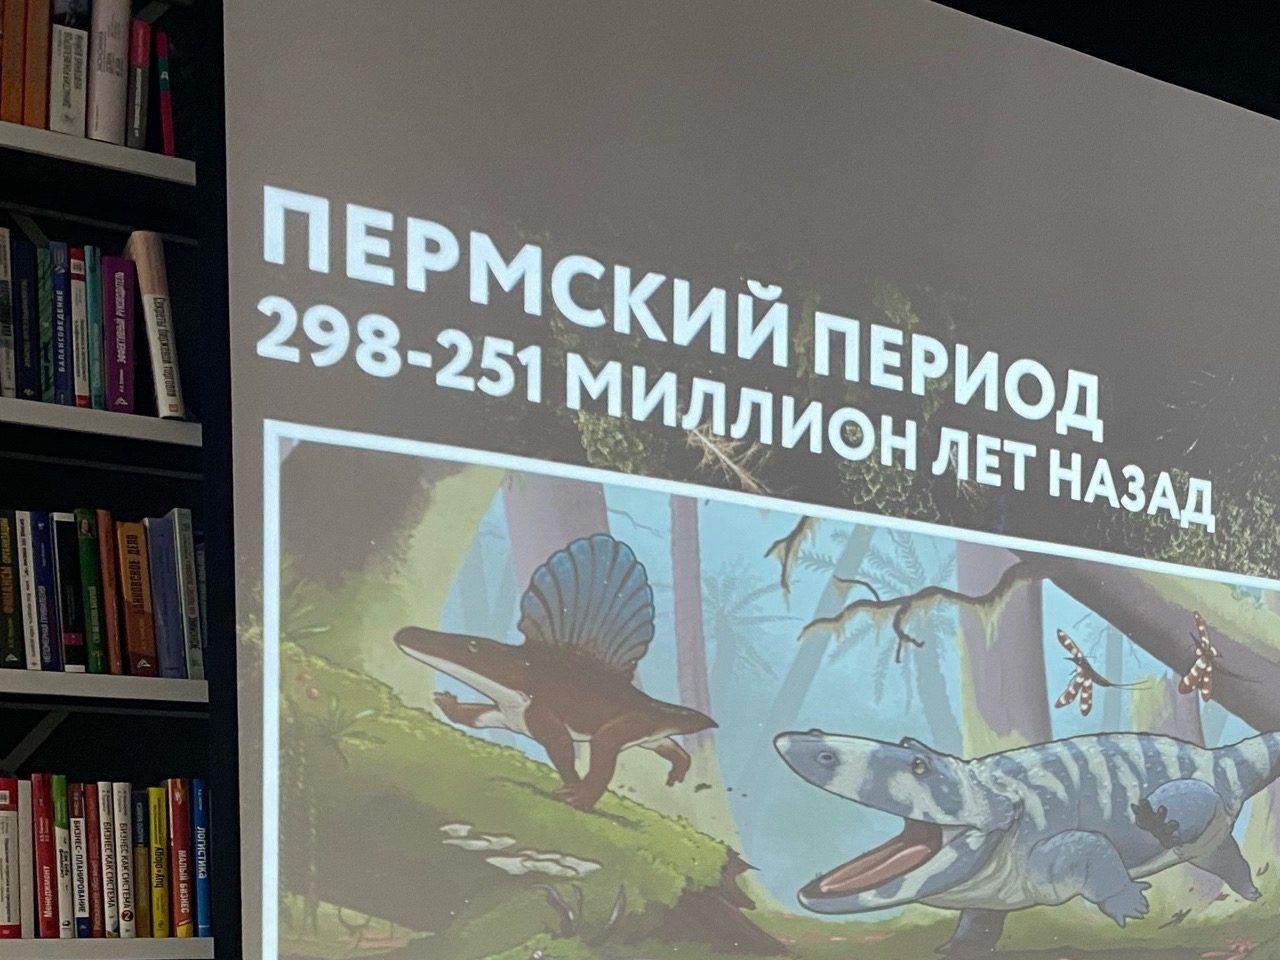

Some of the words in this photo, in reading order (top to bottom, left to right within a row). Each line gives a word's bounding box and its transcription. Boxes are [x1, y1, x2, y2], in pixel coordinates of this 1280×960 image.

[263, 185, 789, 368] ПЕРМСКИЙ
[814, 311, 1104, 443] ПЕРИОД
[55, 290, 65, 372] БАЛАНСОВЕДЕНИЕ
[256, 295, 542, 403] 298-251
[566, 352, 917, 471] МИЛЛИОН
[932, 427, 1036, 490] ЛЕТ
[1049, 449, 1216, 533] НАЗАД
[126, 535, 141, 556] ДЕЛО
[103, 822, 113, 853] БИЗНЕС
[120, 823, 129, 854] БИЗНЕС
[105, 854, 113, 870] КАК
[121, 855, 129, 871] КАК
[178, 850, 188, 880] МАЛЫЙ
[42, 866, 52, 918] Менеджмент
[106, 872, 115, 908] СИСТЕМА
[121, 873, 131, 909] СИСТЕМА
[179, 883, 189, 913] БИЗНЕС
